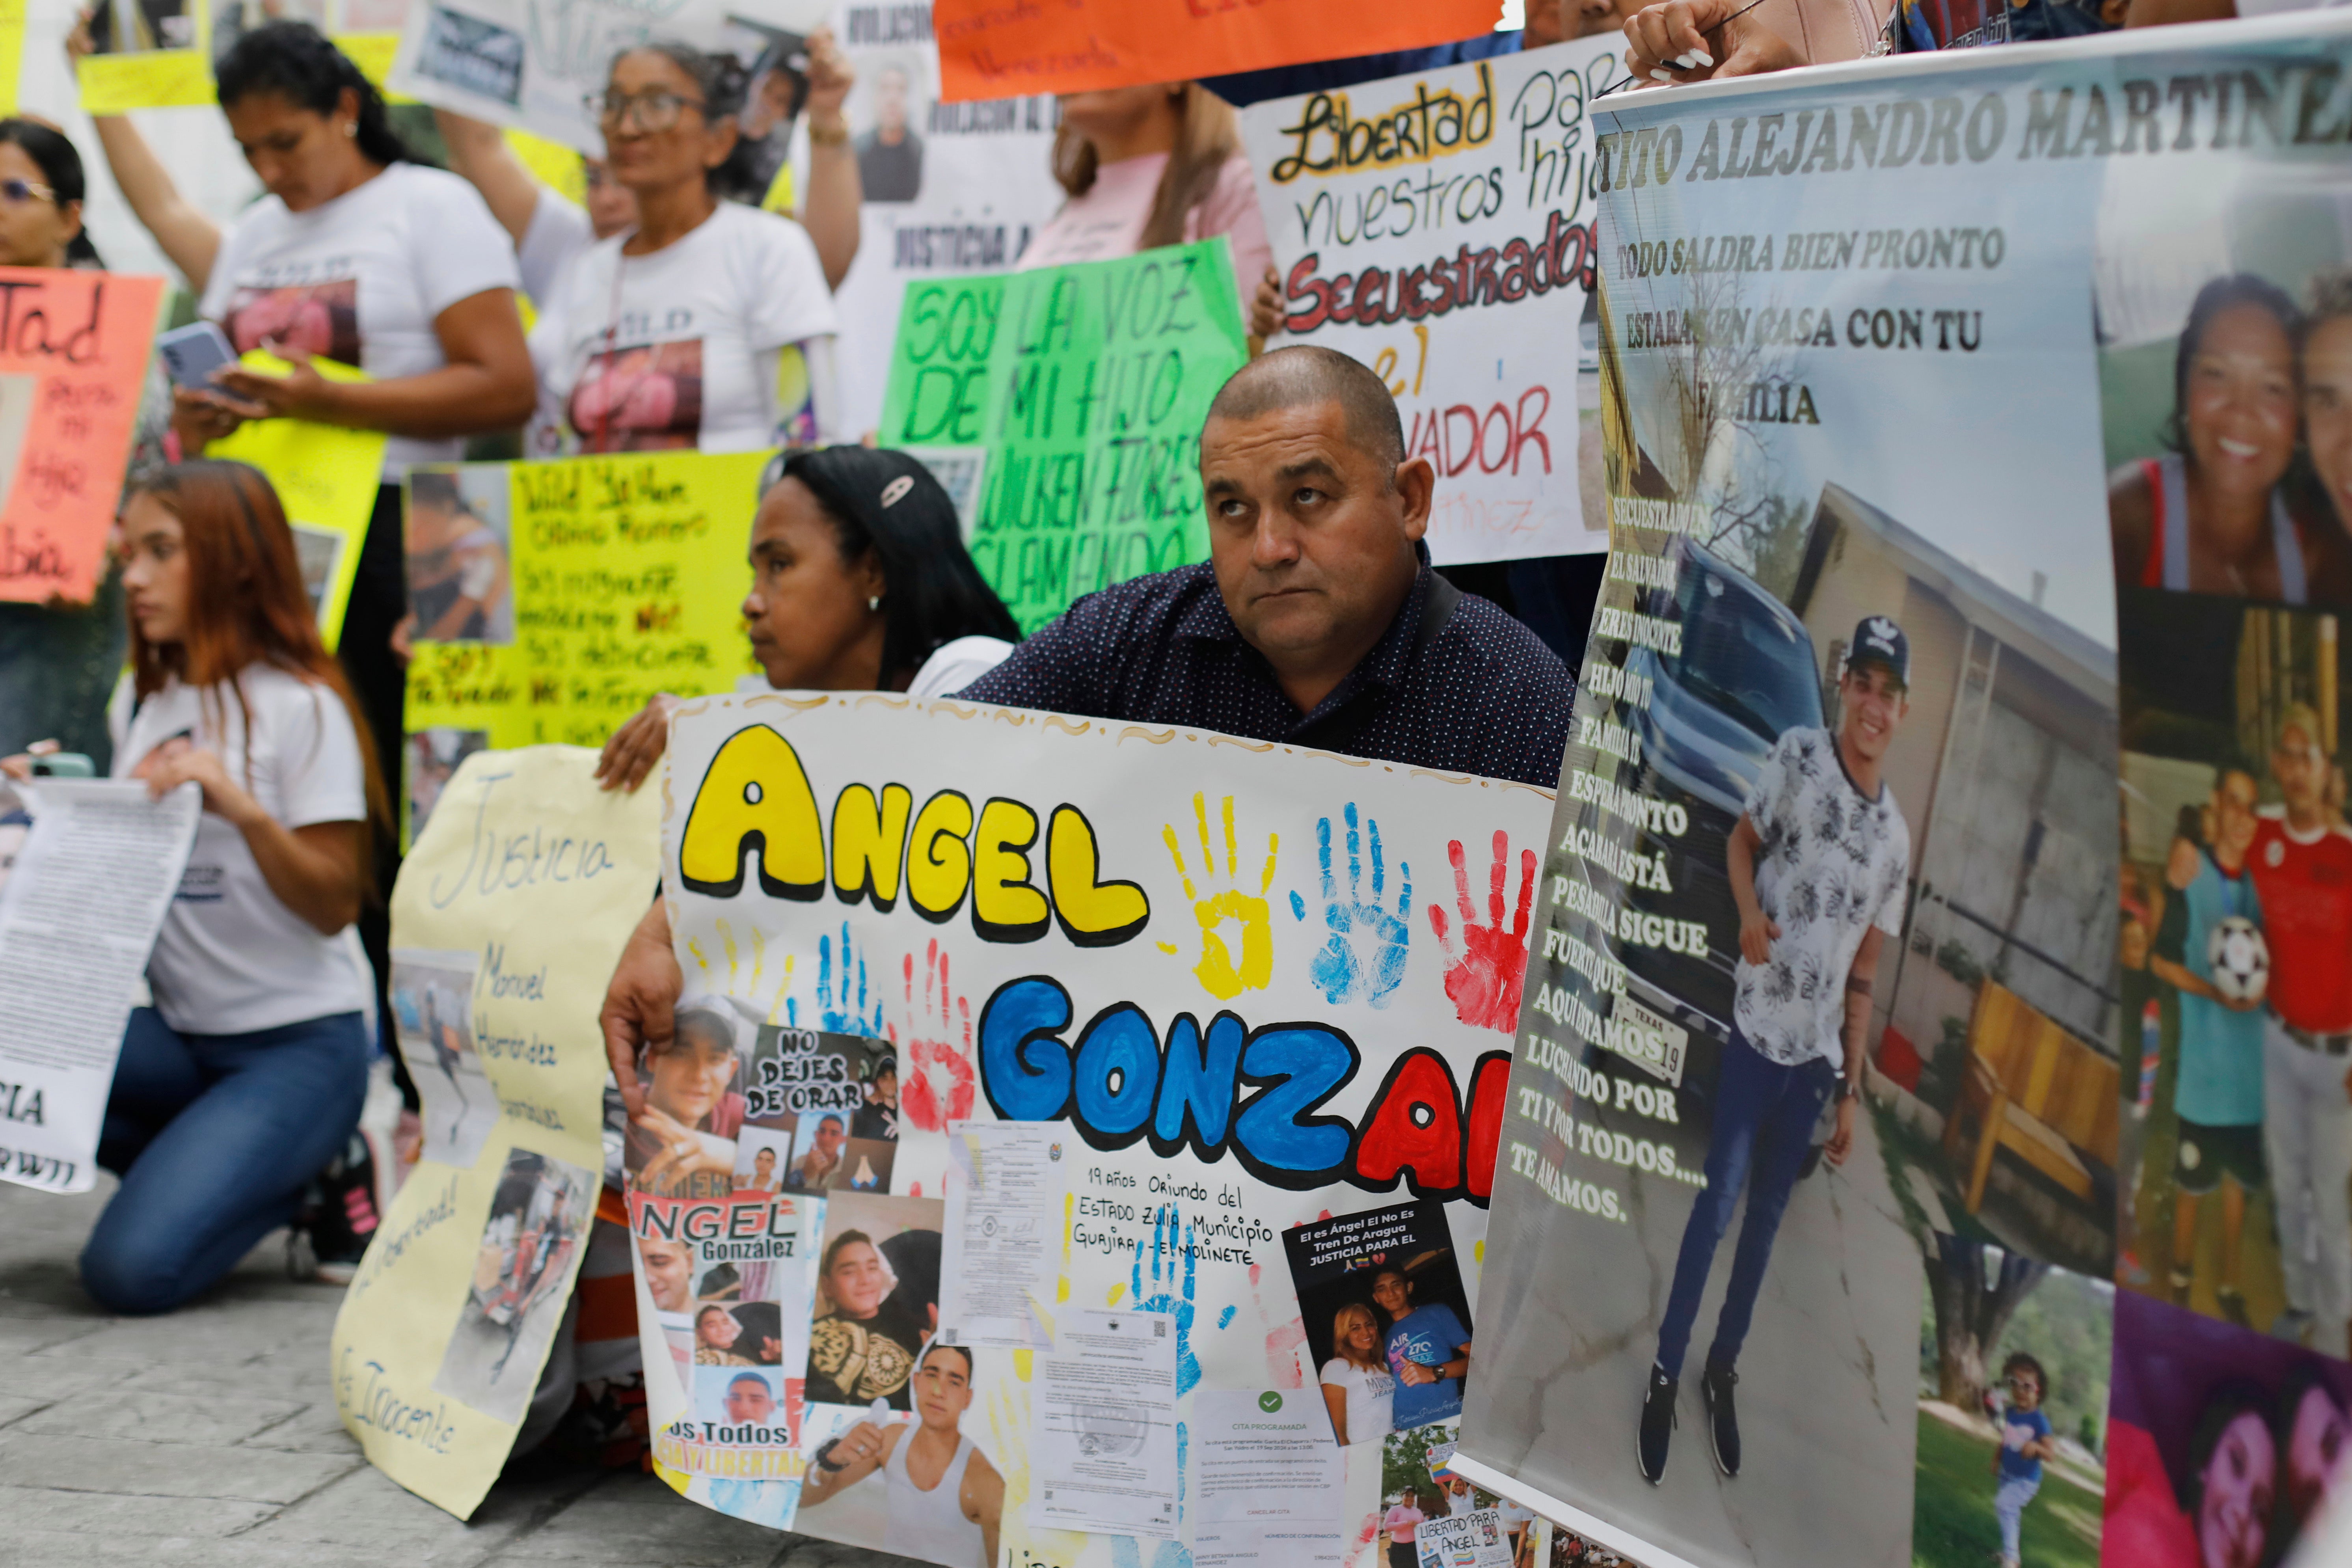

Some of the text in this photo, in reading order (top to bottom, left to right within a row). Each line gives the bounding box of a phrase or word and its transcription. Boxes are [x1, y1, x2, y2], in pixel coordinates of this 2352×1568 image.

[1686, 91, 2007, 182] ALEJANDRO
[2017, 62, 2352, 160] MARTINE
[1295, 166, 1504, 248] nuestros
[1617, 227, 2006, 280] TODO SALDRA BIEN PRONTO
[905, 256, 1198, 364] SOY LA VOZ
[1710, 307, 1750, 346] EN
[1754, 307, 1838, 347] CASA
[1846, 308, 1924, 350] CON
[1933, 310, 1983, 352] TU
[902, 349, 1181, 443] DE MI HIJO
[1610, 550, 1625, 580] EL
[1597, 607, 1633, 641] ERES
[1588, 663, 1625, 698] HIJO
[1579, 716, 1631, 760] FAMILIA
[1569, 769, 1620, 815] ESPERA
[428, 771, 615, 911] Justicia
[679, 722, 1151, 947] ANGEL
[1618, 848, 1674, 893] ESTÁ
[1551, 875, 1709, 958] PESADILLA SIGUE
[1591, 955, 1628, 996] QUE
[1577, 1003, 1664, 1062] ESTAMOS
[1635, 1007, 1664, 1033] TEXAS
[779, 1029, 818, 1056] NO
[760, 1056, 847, 1086] DEJES
[1525, 1033, 1680, 1124] LUCHANDO POR
[746, 1085, 862, 1117] DE ORAR
[1519, 1086, 1543, 1121] TI
[1544, 1097, 1556, 1128] Y
[1553, 1105, 1574, 1149] POR
[1088, 1168, 1102, 1185] 19
[1510, 1141, 1628, 1223] TE AMAMOS.
[1193, 1214, 1273, 1247] Municipio
[1300, 1209, 1415, 1243] El es Ángel El No Es
[1313, 1224, 1407, 1252] Tren De Aragua
[702, 1238, 794, 1261] González
[1309, 1234, 1417, 1267] JUSTICIA PARA EL
[1391, 1332, 1410, 1350] AIR
[702, 1422, 788, 1444] Todos
[1420, 1511, 1501, 1539] LIBERTAD PARA
[1442, 1535, 1480, 1554] ANGEL
